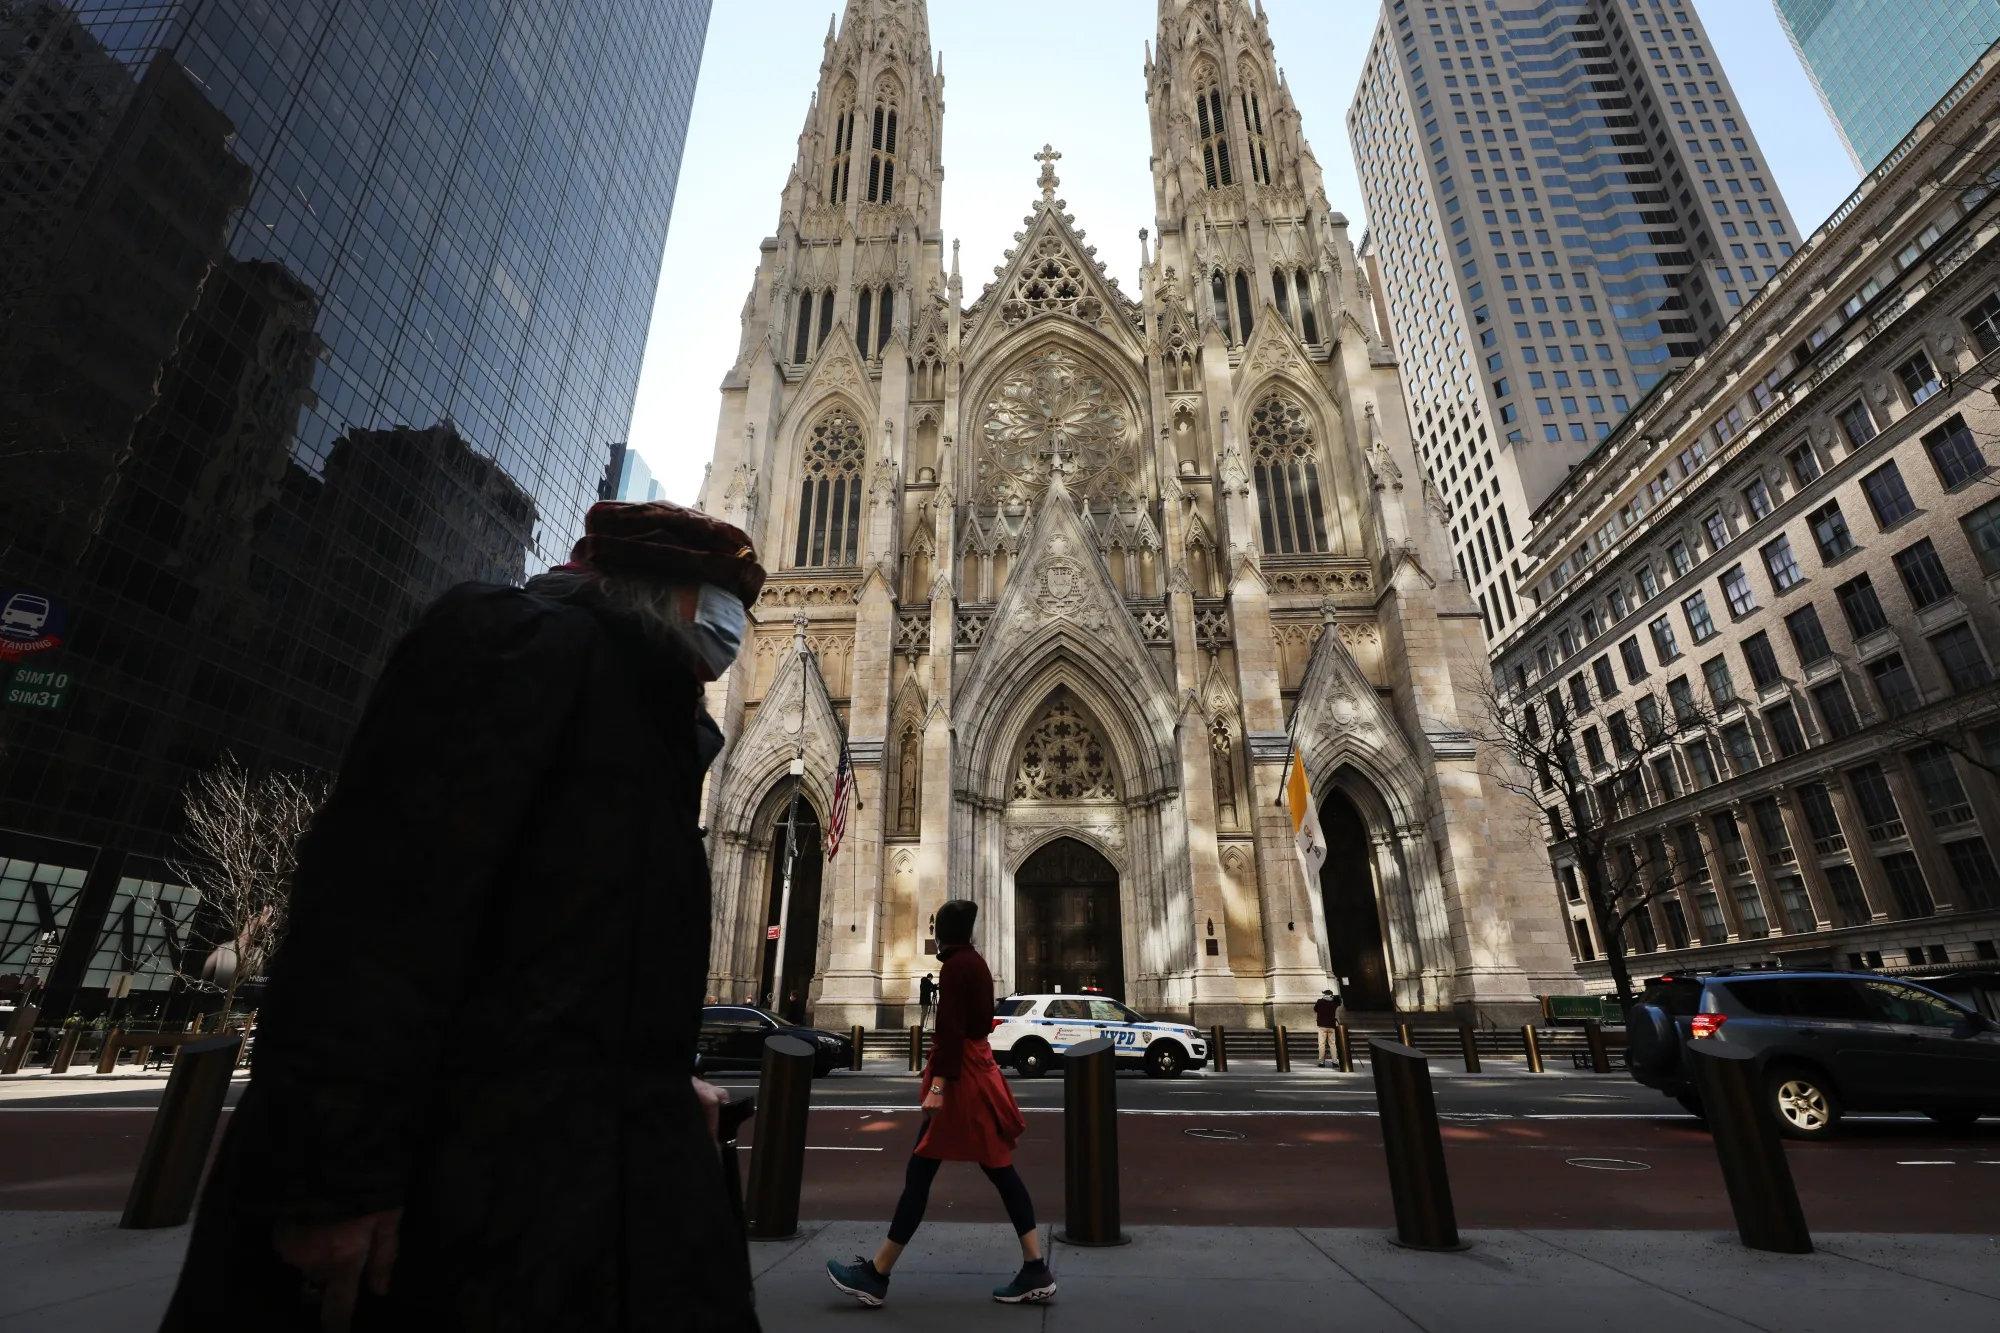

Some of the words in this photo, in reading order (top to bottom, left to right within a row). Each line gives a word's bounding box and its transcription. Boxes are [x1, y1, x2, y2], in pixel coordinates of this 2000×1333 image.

[15, 669, 68, 688] SIM10
[9, 689, 60, 708] SIM31
[1100, 1030, 1136, 1045] NYPD
